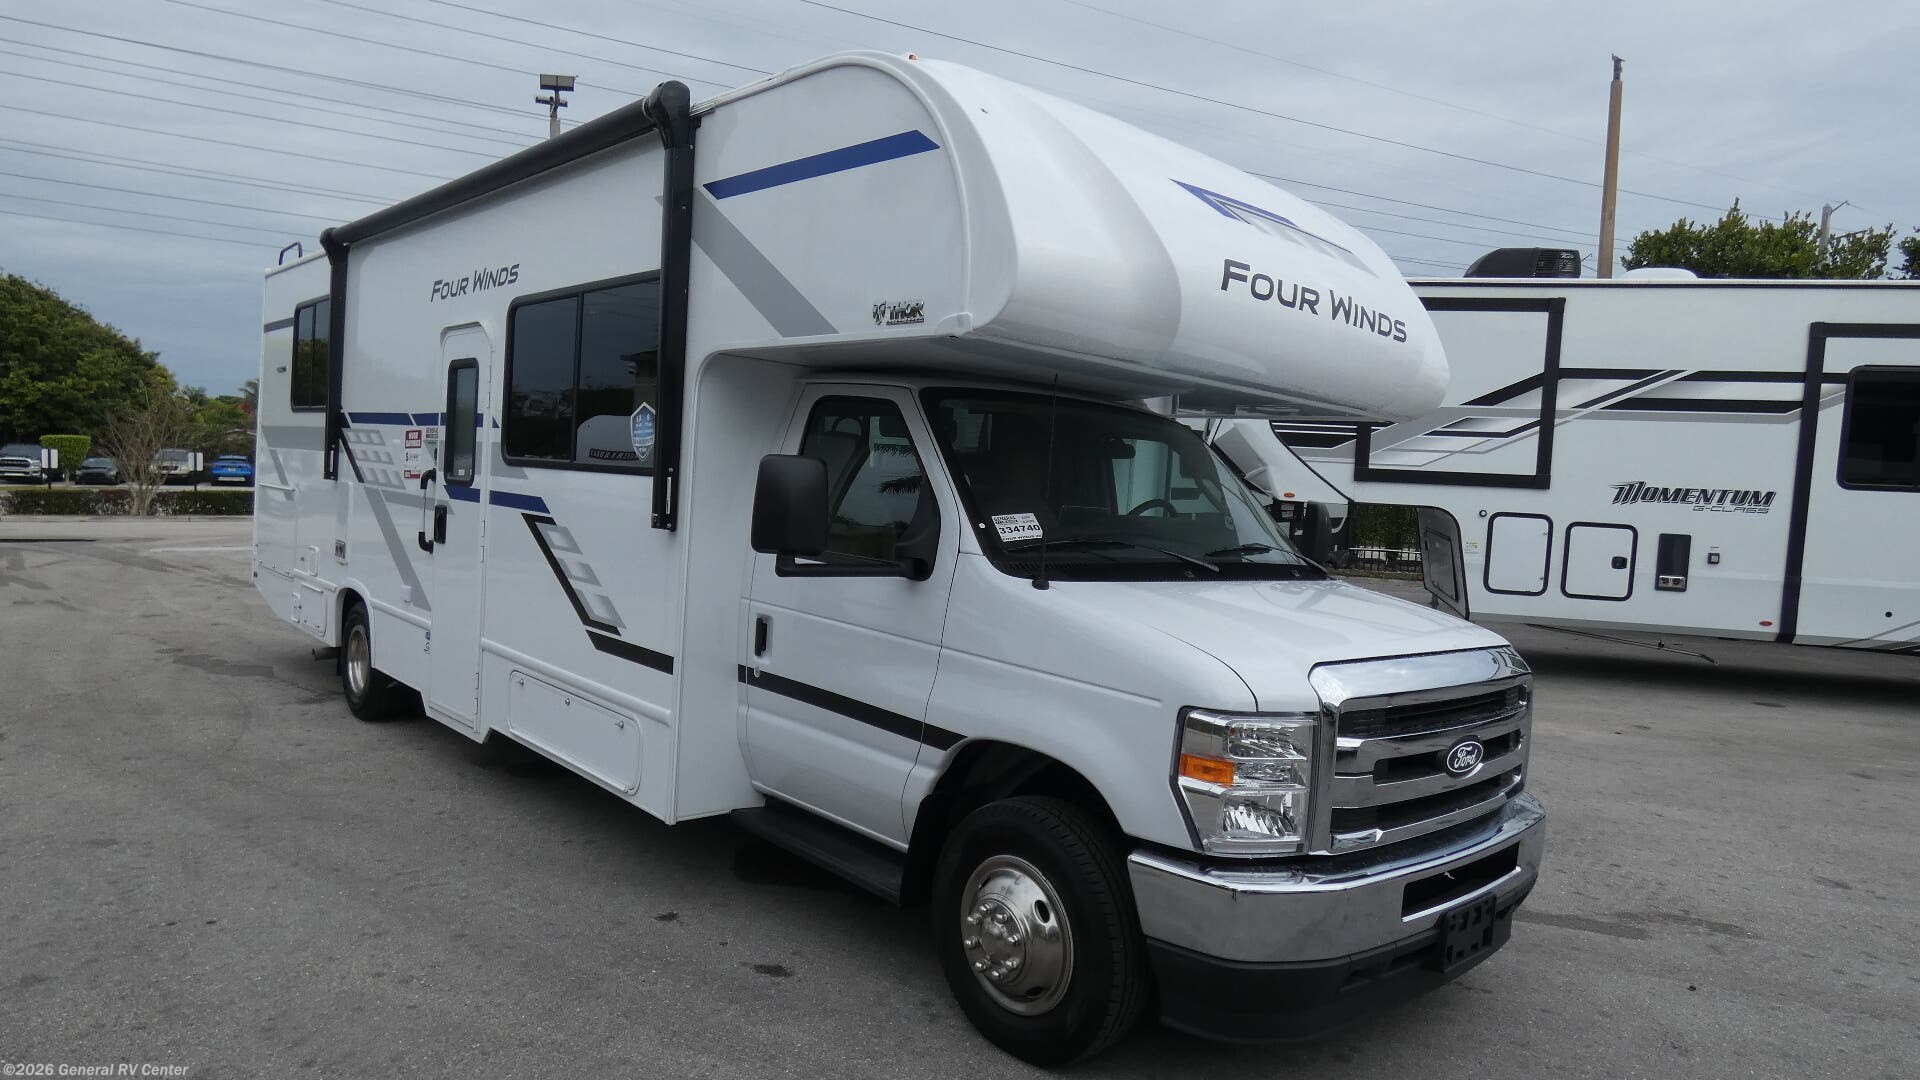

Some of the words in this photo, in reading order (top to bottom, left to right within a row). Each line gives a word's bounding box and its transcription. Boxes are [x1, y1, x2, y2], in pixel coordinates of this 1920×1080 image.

[431, 278, 469, 302] FOUR
[472, 264, 519, 292] WINDS
[1221, 258, 1320, 316] FOUR
[1329, 289, 1408, 343] WINDS
[1608, 481, 1776, 507] MOMENTUM
[1693, 505, 1769, 514] G-CLASS
[999, 525, 1040, 534] 334740
[1454, 748, 1477, 768] Ford
